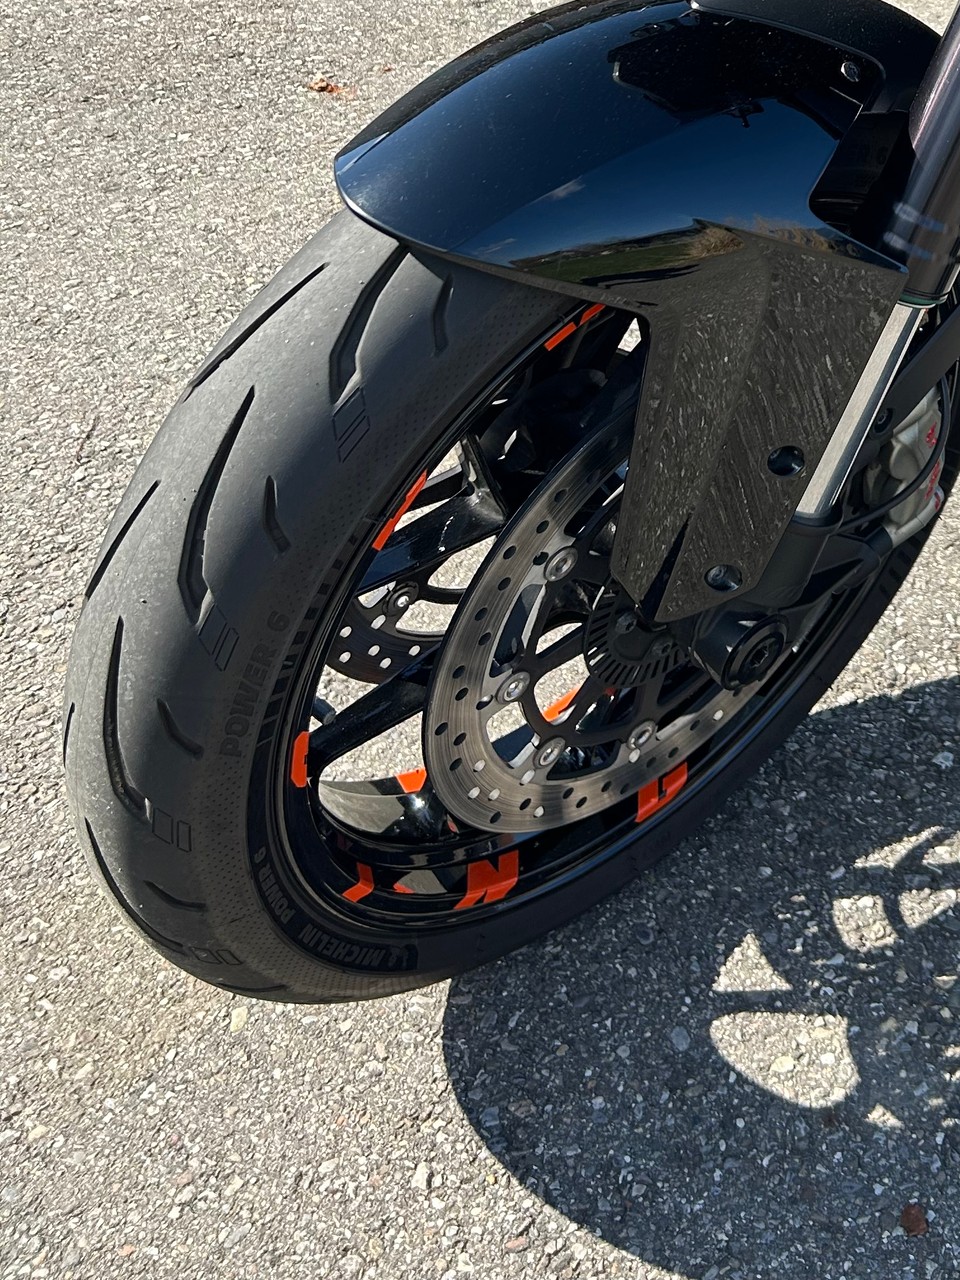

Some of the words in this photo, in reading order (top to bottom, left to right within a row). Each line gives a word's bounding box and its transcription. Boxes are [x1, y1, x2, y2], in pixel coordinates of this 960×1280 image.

[219, 642, 278, 758] POWER
[266, 610, 290, 632] 6
[253, 845, 267, 864] 6
[257, 861, 297, 925] POWER
[297, 922, 387, 967] MICHELIN
